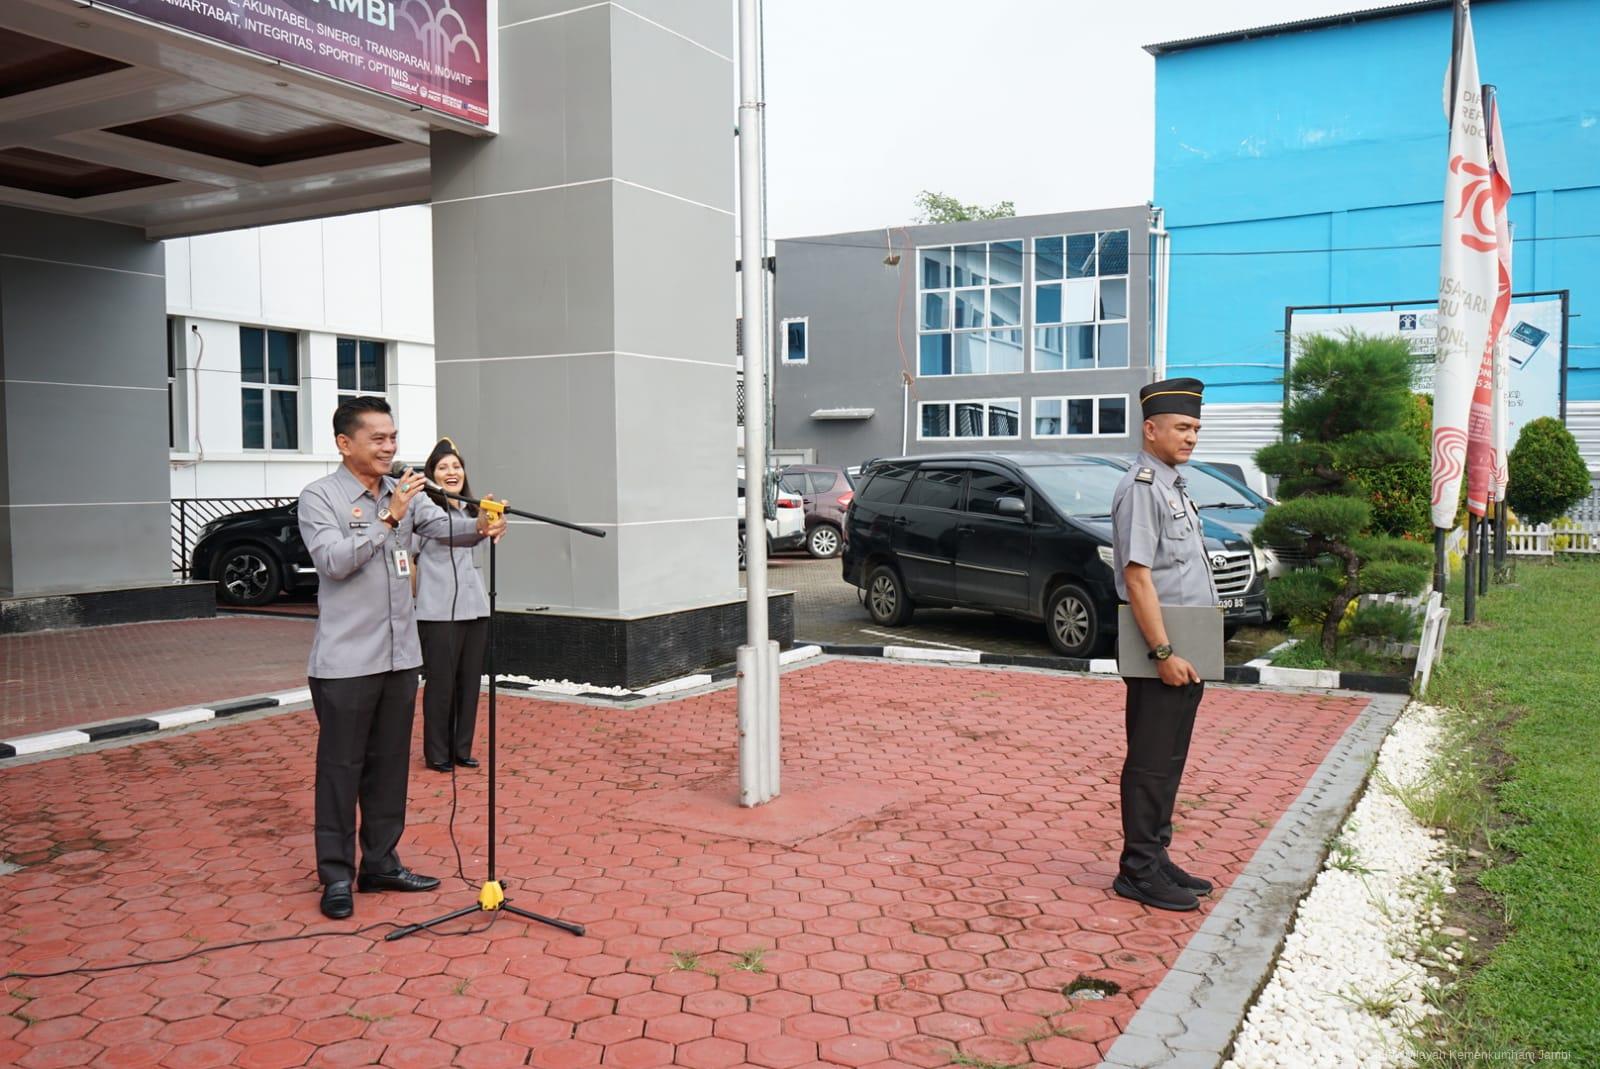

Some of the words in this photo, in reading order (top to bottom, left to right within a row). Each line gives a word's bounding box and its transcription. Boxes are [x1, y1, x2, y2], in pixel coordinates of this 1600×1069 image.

[243, 0, 313, 33] AKUNTABEL,
[317, 23, 363, 49] SINERGI,
[365, 40, 432, 74] TRANSPARAN,
[435, 65, 473, 86] INOVATIF
[244, 17, 315, 50] INTEGRITAS,
[319, 44, 365, 70] SPORTIF,
[368, 60, 408, 81] OPTIMIS
